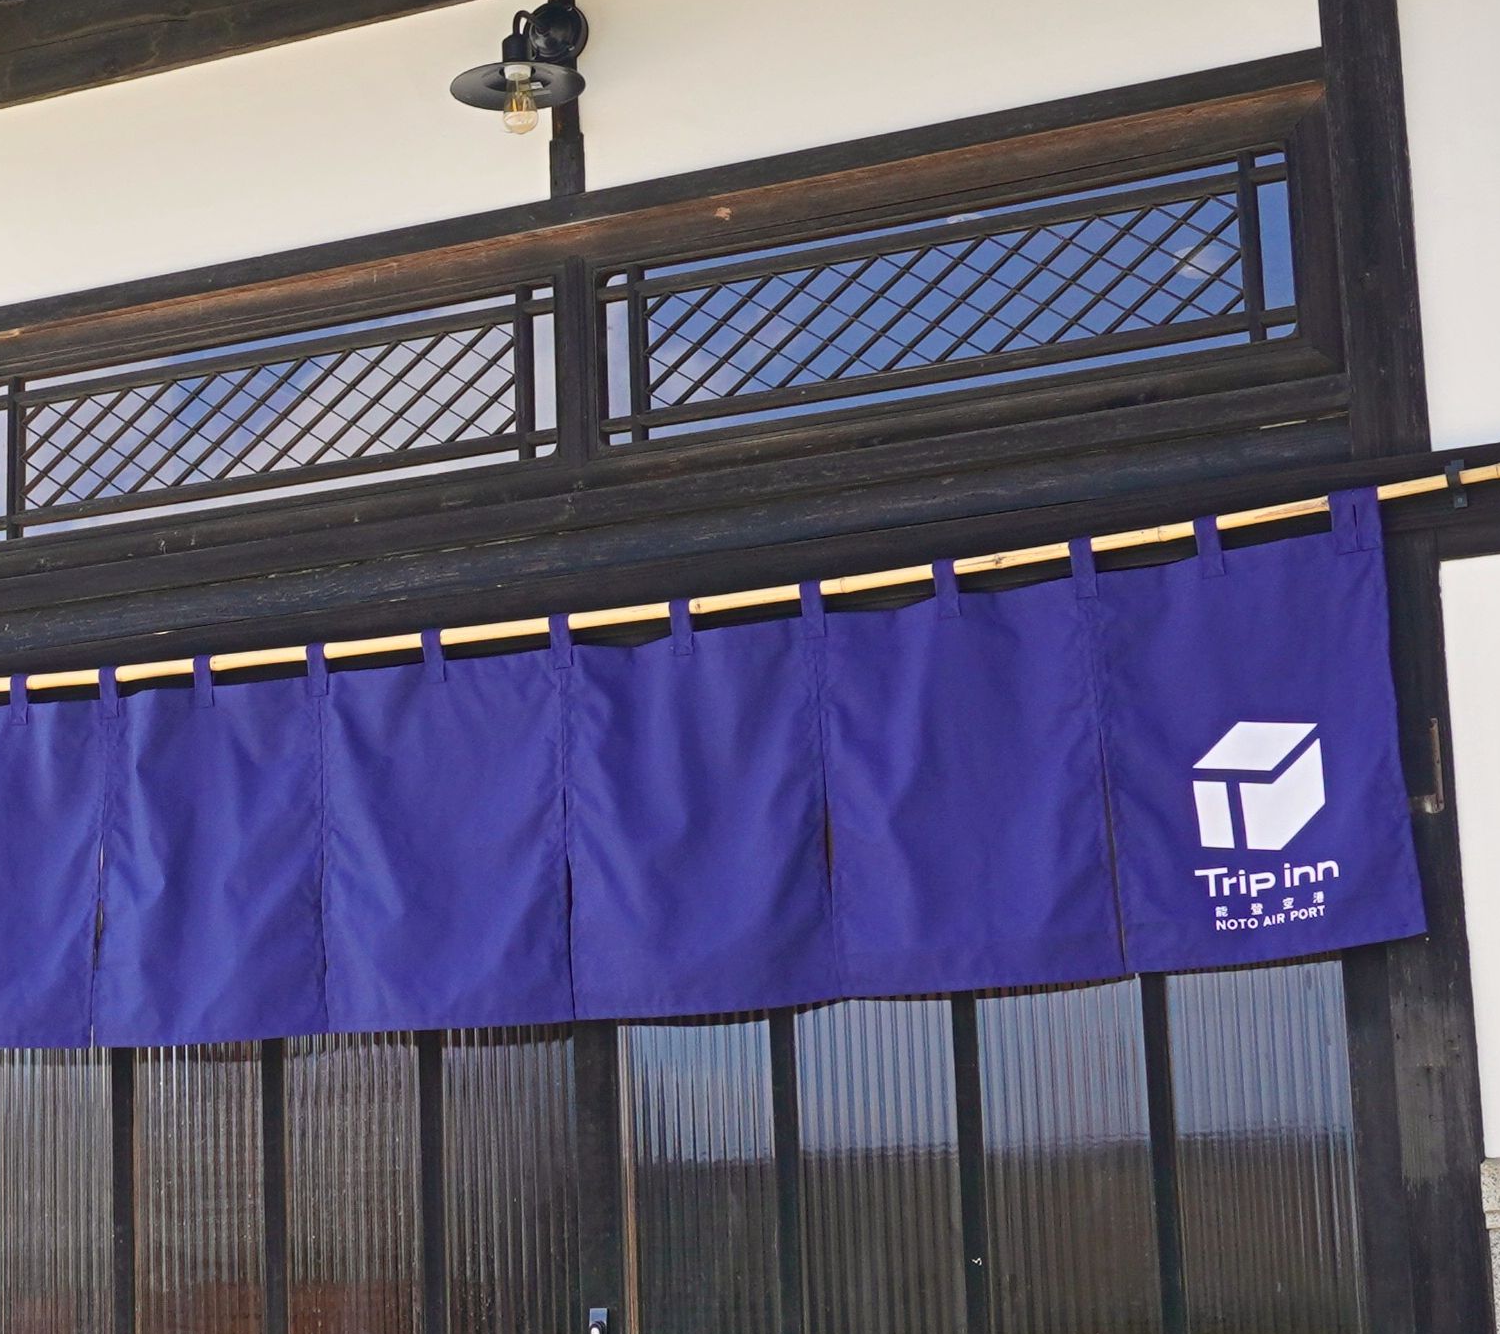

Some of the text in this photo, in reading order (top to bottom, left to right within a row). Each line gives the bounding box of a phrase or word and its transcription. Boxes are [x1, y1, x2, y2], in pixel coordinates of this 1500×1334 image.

[1194, 860, 1341, 898] Trip inn
[1215, 904, 1326, 931] NOTO AIR PORT
